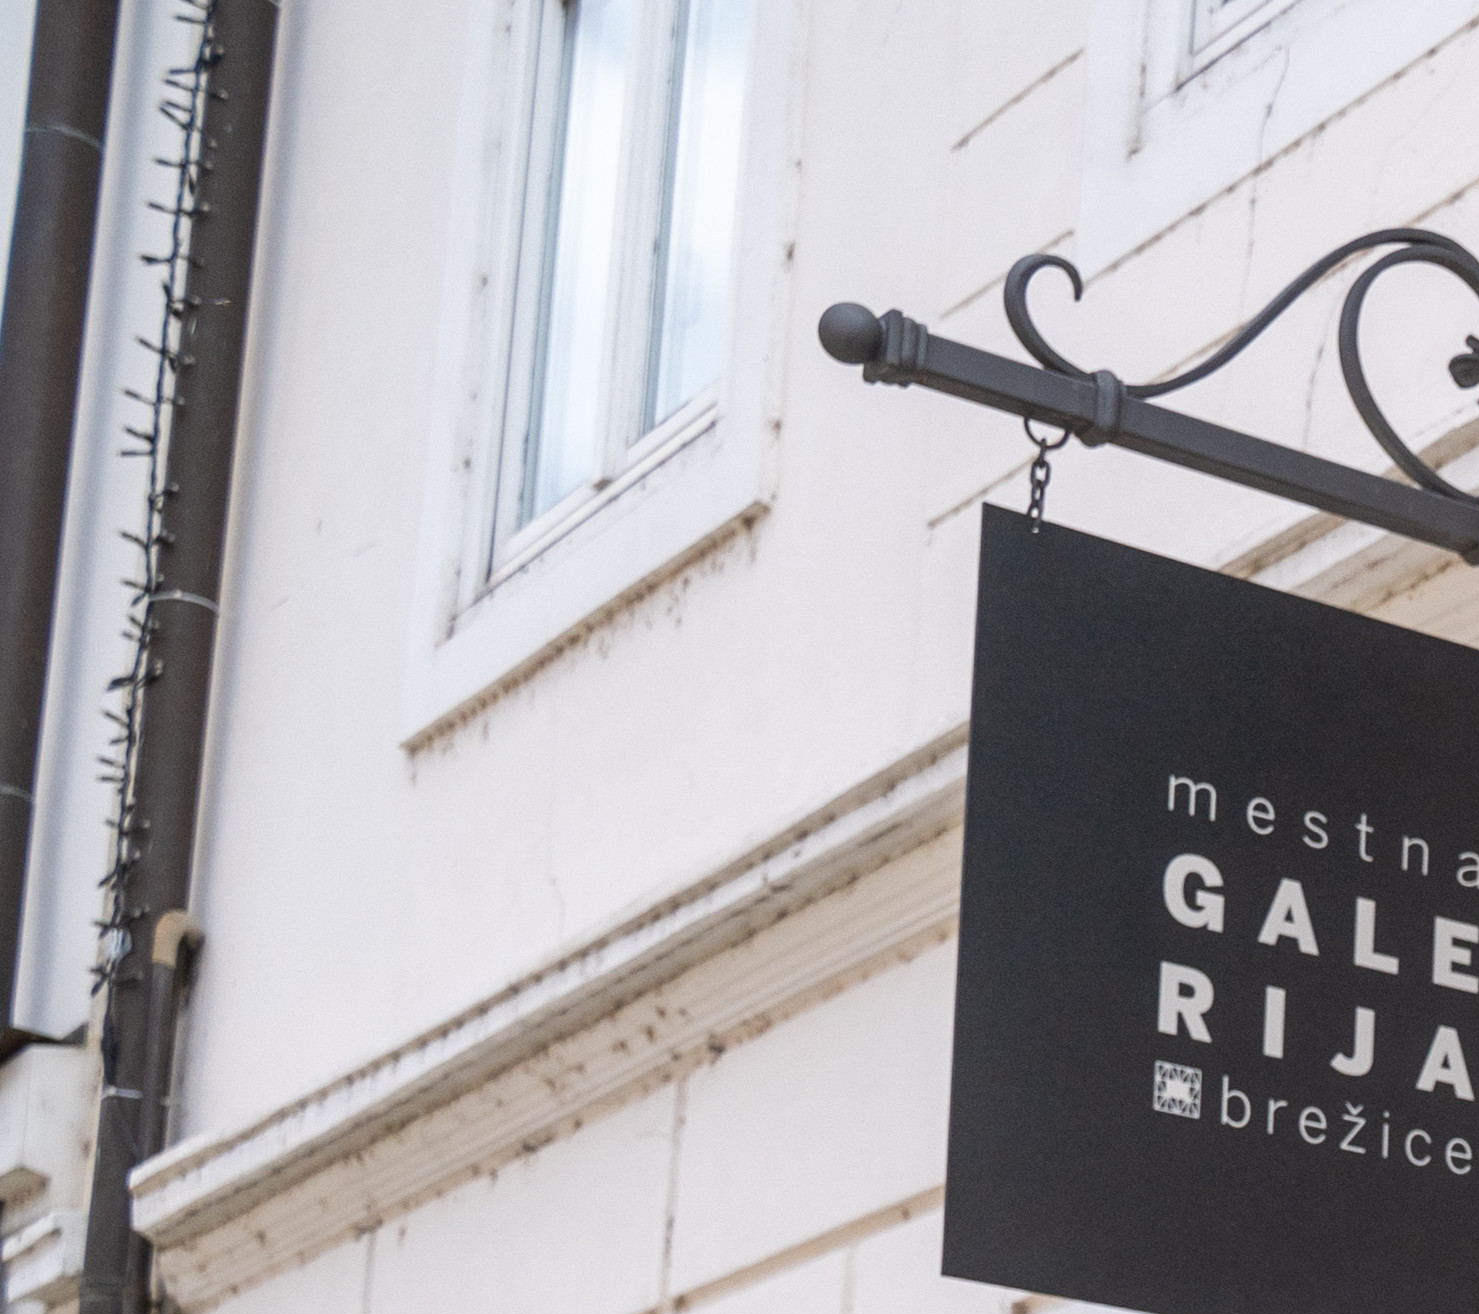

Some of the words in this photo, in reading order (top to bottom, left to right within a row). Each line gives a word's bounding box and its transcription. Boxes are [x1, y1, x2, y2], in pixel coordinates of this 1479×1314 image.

[1162, 852, 1479, 994] GALE
[1156, 961, 1475, 1101] RIJA
[1220, 1075, 1475, 1175] brežice
